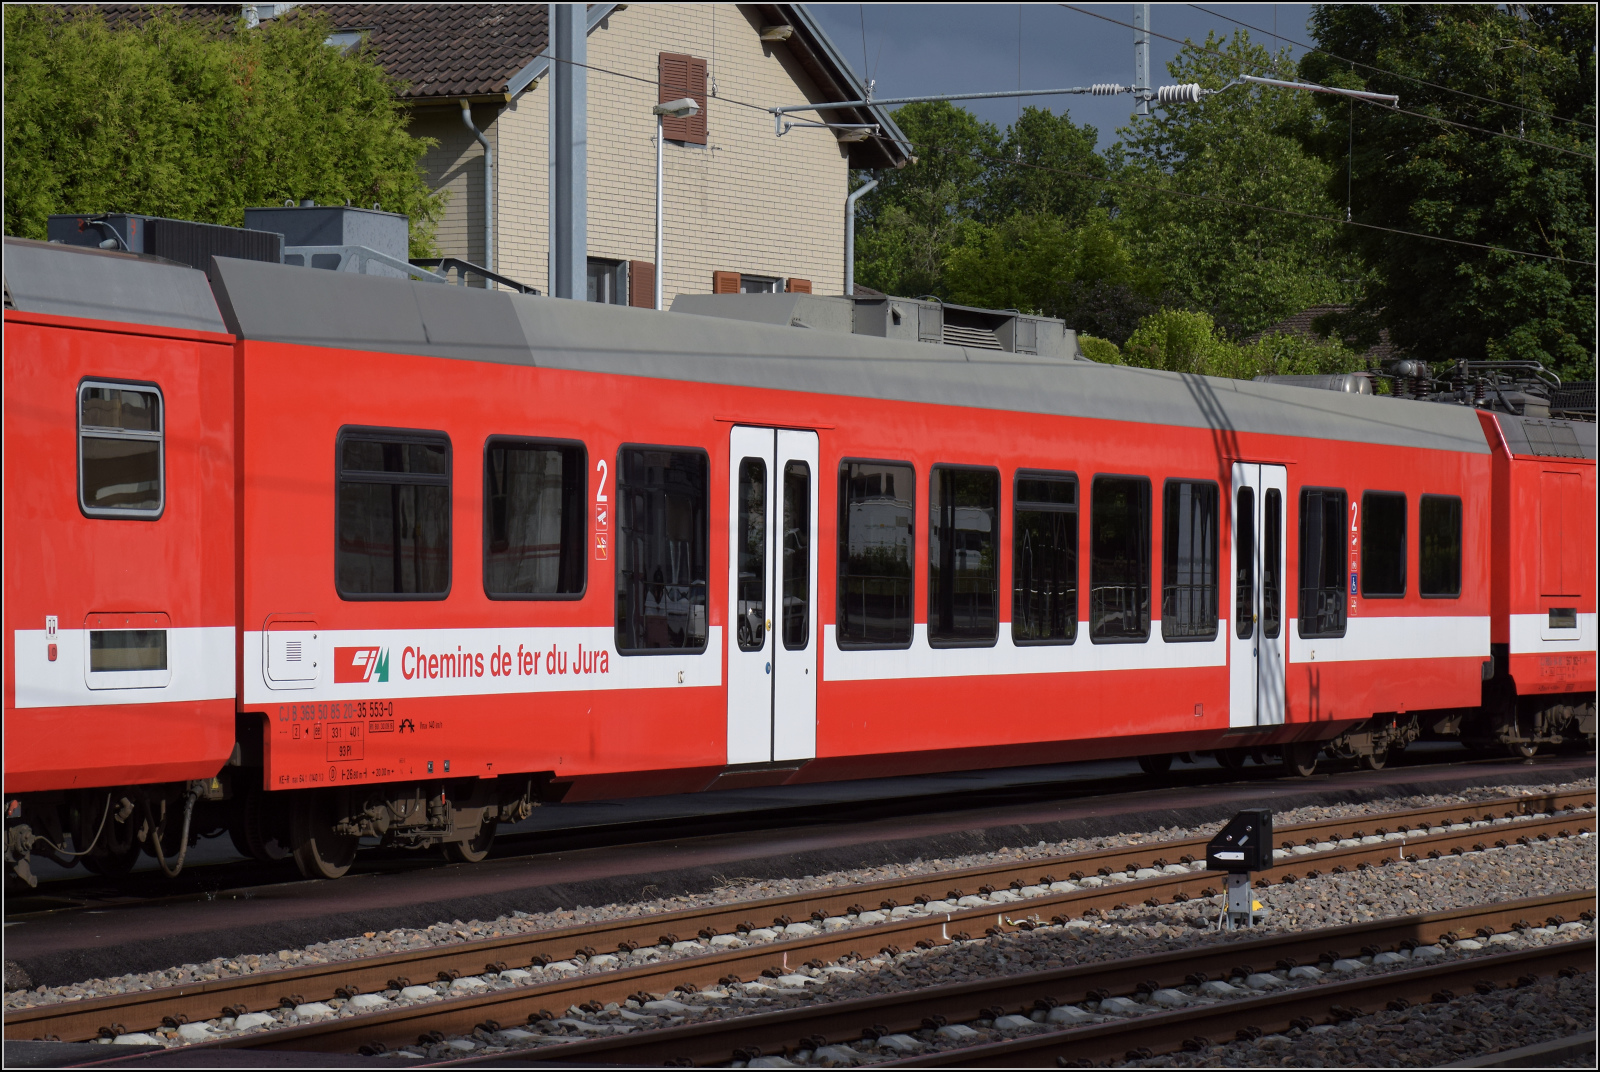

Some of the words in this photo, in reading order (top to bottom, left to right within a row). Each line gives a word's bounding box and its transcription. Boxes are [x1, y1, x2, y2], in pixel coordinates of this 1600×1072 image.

[597, 459, 608, 502] 2
[1351, 501, 1358, 532] 2
[402, 645, 484, 680] Chemins
[490, 645, 512, 677] de
[517, 643, 541, 676] fer
[546, 643, 567, 675] du
[572, 643, 609, 675] Jura
[279, 705, 290, 722] CJ
[292, 705, 298, 721] B
[300, 704, 315, 721] 369
[318, 704, 328, 720] 50
[330, 703, 340, 719] 85
[343, 702, 367, 719] 20-35
[369, 701, 393, 718] 553-0
